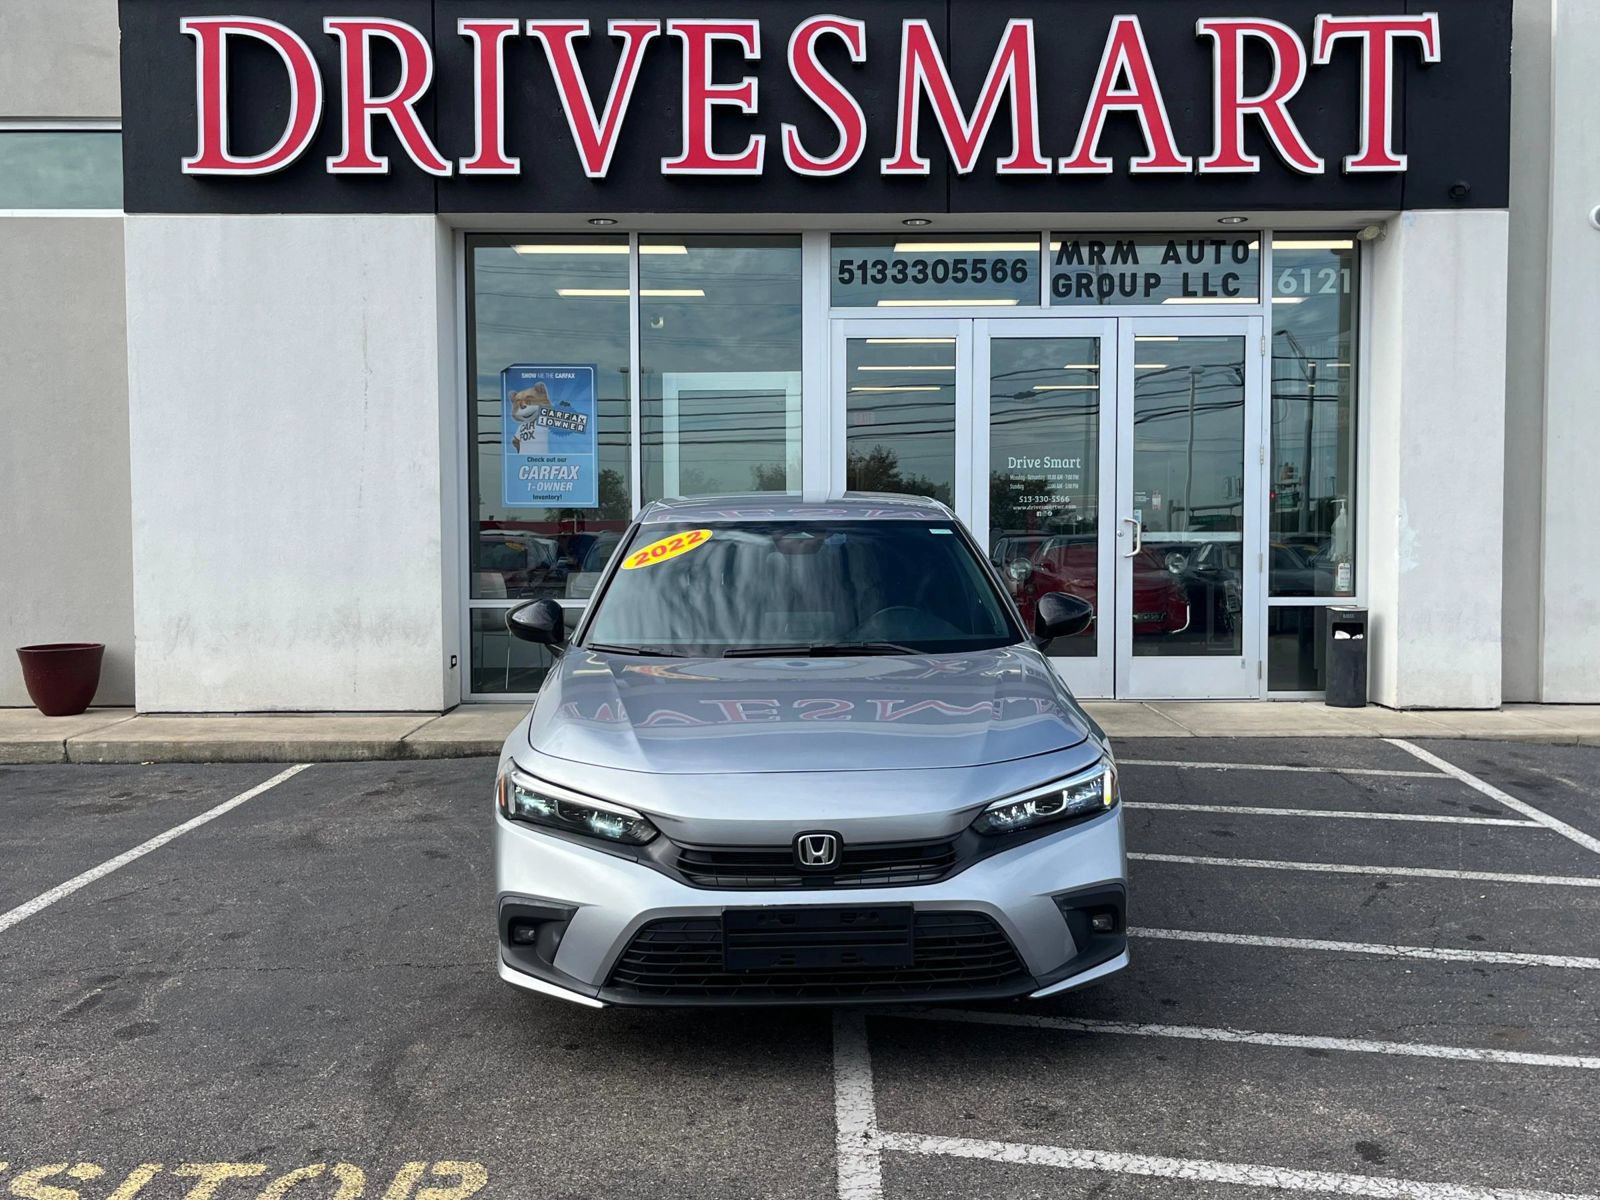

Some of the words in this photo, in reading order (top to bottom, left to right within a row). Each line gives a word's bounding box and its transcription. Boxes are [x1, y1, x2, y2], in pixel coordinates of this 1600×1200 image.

[179, 12, 1441, 177] DRIVESMART
[1055, 240, 1140, 266] MRM
[1160, 239, 1250, 265] AUTO
[838, 258, 1028, 285] 5133305566
[1277, 267, 1351, 294] 6121
[1052, 272, 1162, 298] GROUP
[1182, 272, 1240, 297] LLC
[541, 408, 586, 424] CARFAX
[520, 430, 536, 441] FOX
[519, 465, 579, 480] CARFAX
[1008, 456, 1041, 469] Drive
[1043, 456, 1080, 469] Smart
[633, 531, 703, 567] 2022
